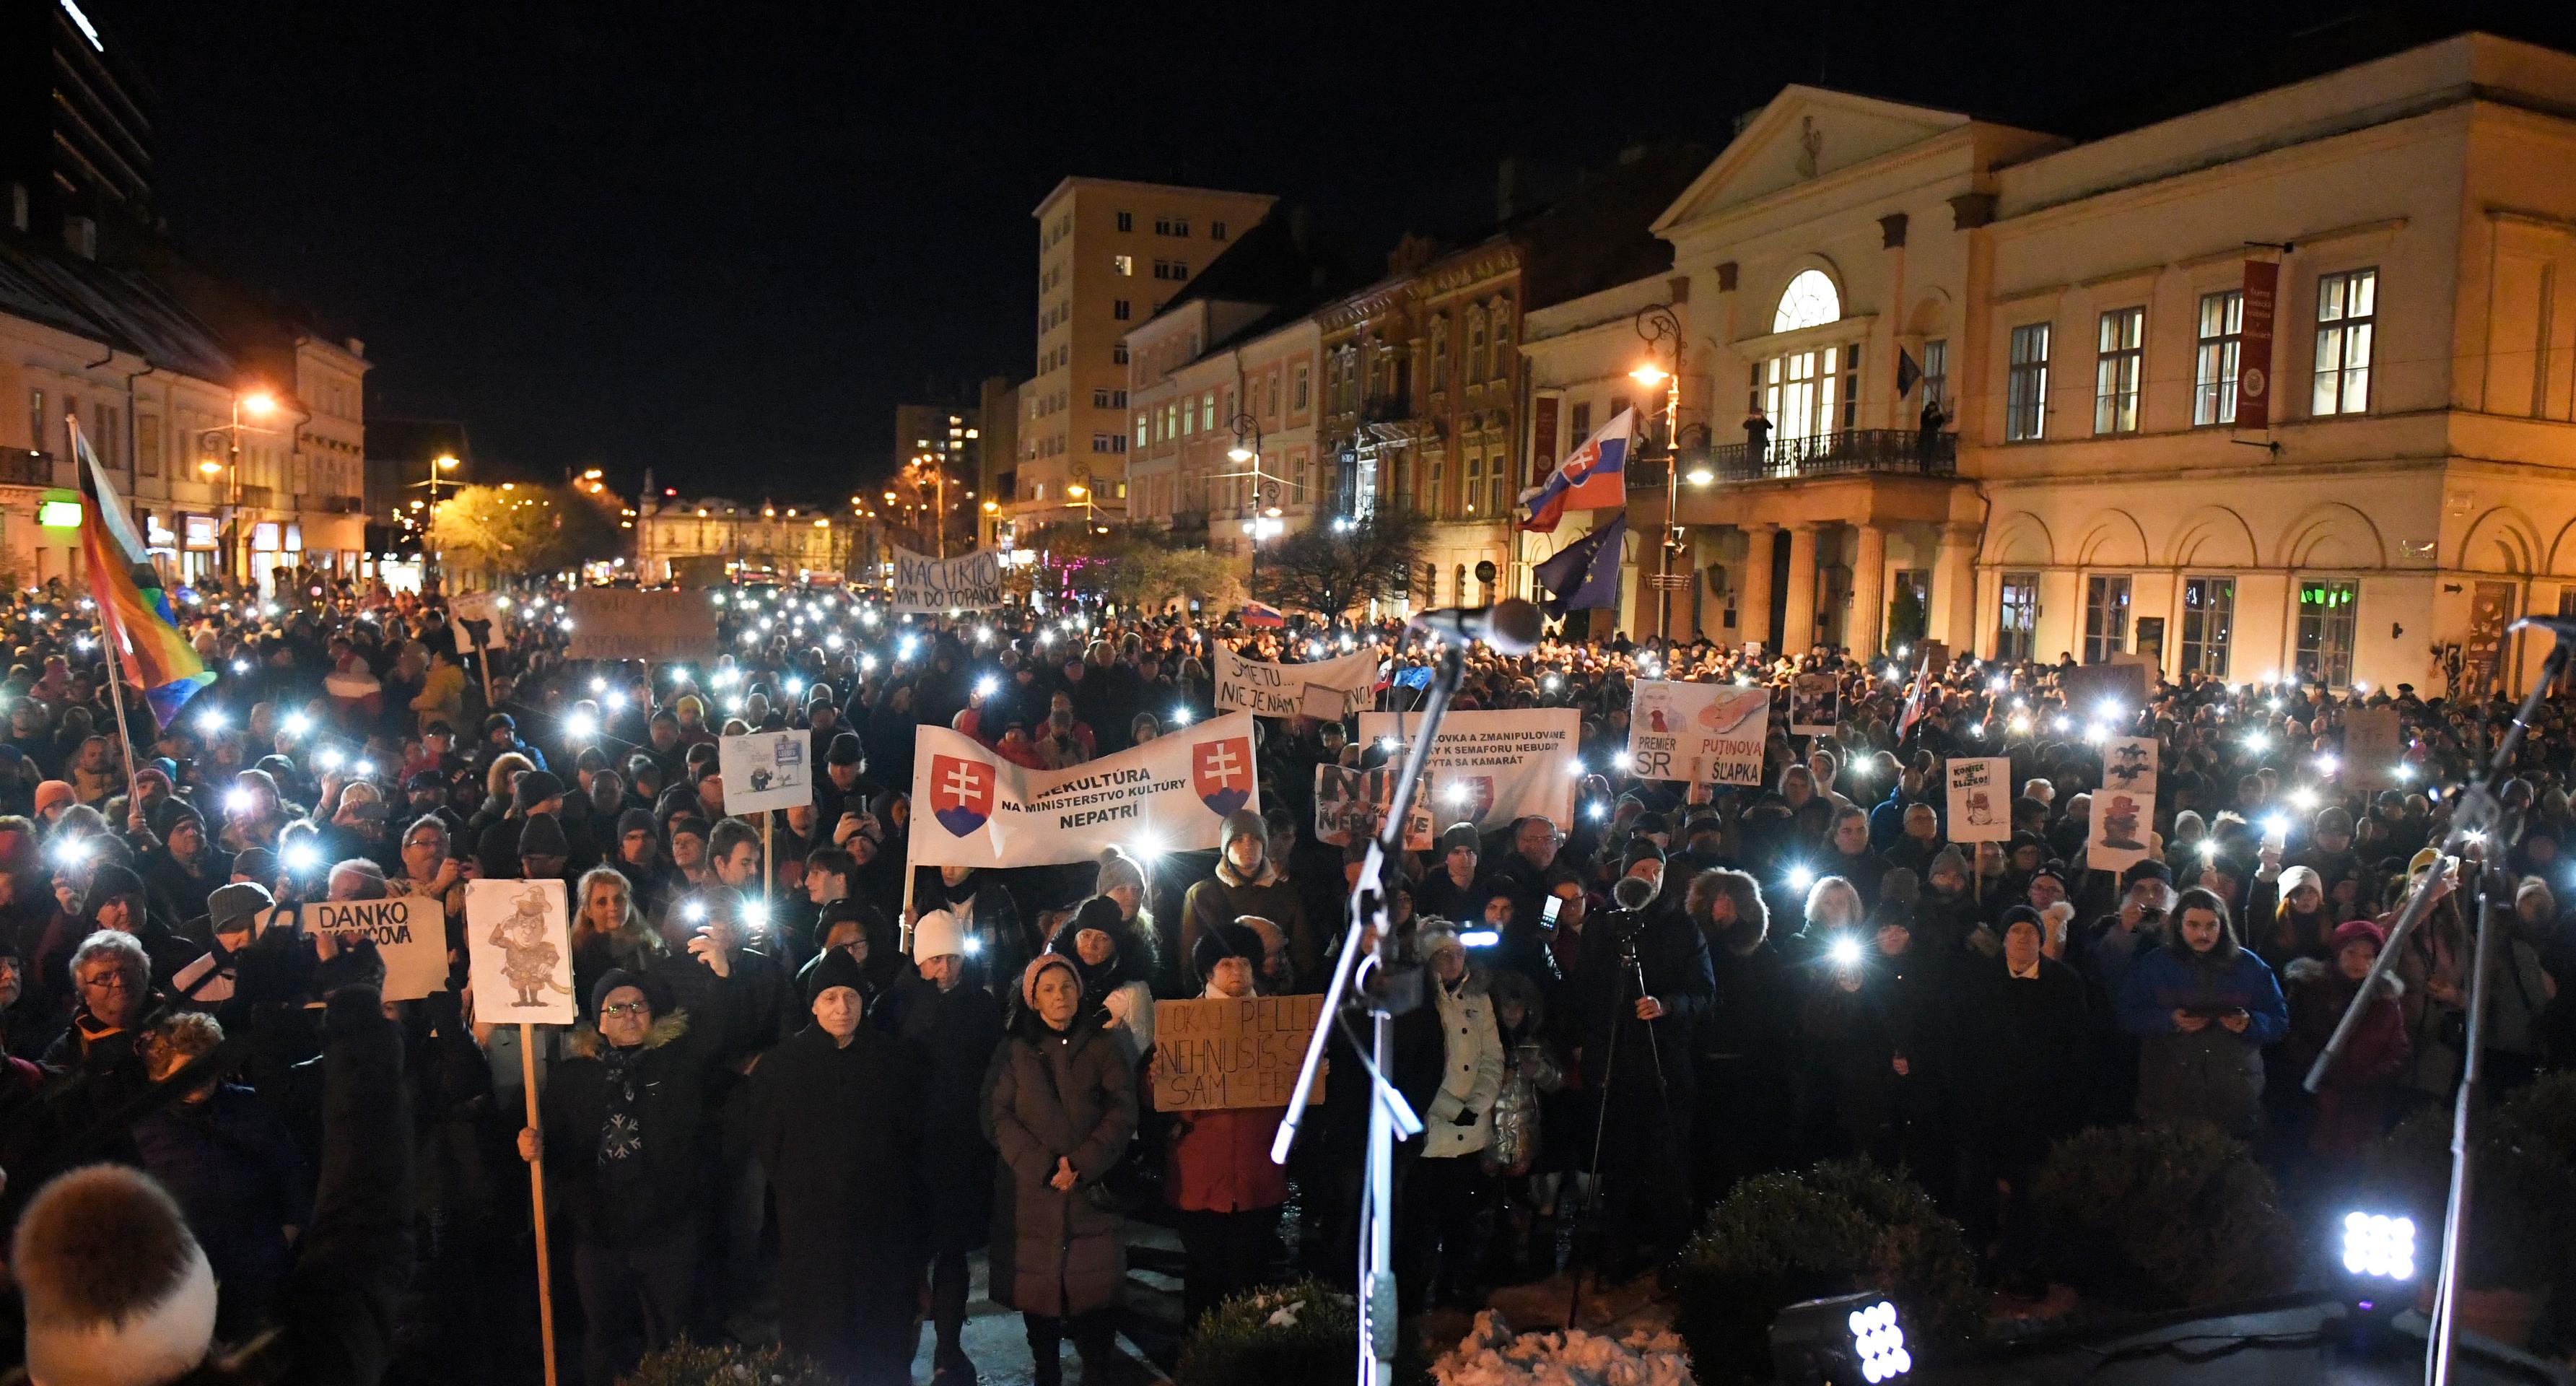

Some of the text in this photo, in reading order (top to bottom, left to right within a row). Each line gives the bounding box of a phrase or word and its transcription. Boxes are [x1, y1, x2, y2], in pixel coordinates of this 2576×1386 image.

[925, 590, 944, 607] DO
[1221, 681, 1247, 706] NIE
[1249, 689, 1265, 710] JE
[1267, 694, 1295, 714] NÁM
[1480, 729, 1566, 742] ZMANIPULOVANÉ
[1638, 734, 1676, 751] PREMIÉR
[1701, 738, 1762, 757] PUTINOVA
[1455, 744, 1512, 754] SEMAFORU
[1455, 757, 1468, 766] SA
[1471, 754, 1524, 765] KAMARÁT
[1636, 751, 1671, 777] SR
[1953, 764, 1985, 776] KONIEC
[1001, 779, 1187, 814] NA MINISTERSTVO KULTÚRY
[1036, 768, 1151, 799] NEKULTÚRA
[1060, 801, 1138, 829] NEPATRÍ
[319, 901, 409, 928] DANKO
[1159, 1004, 1223, 1036] LOKAJ
[1170, 1073, 1226, 1106] SAM
